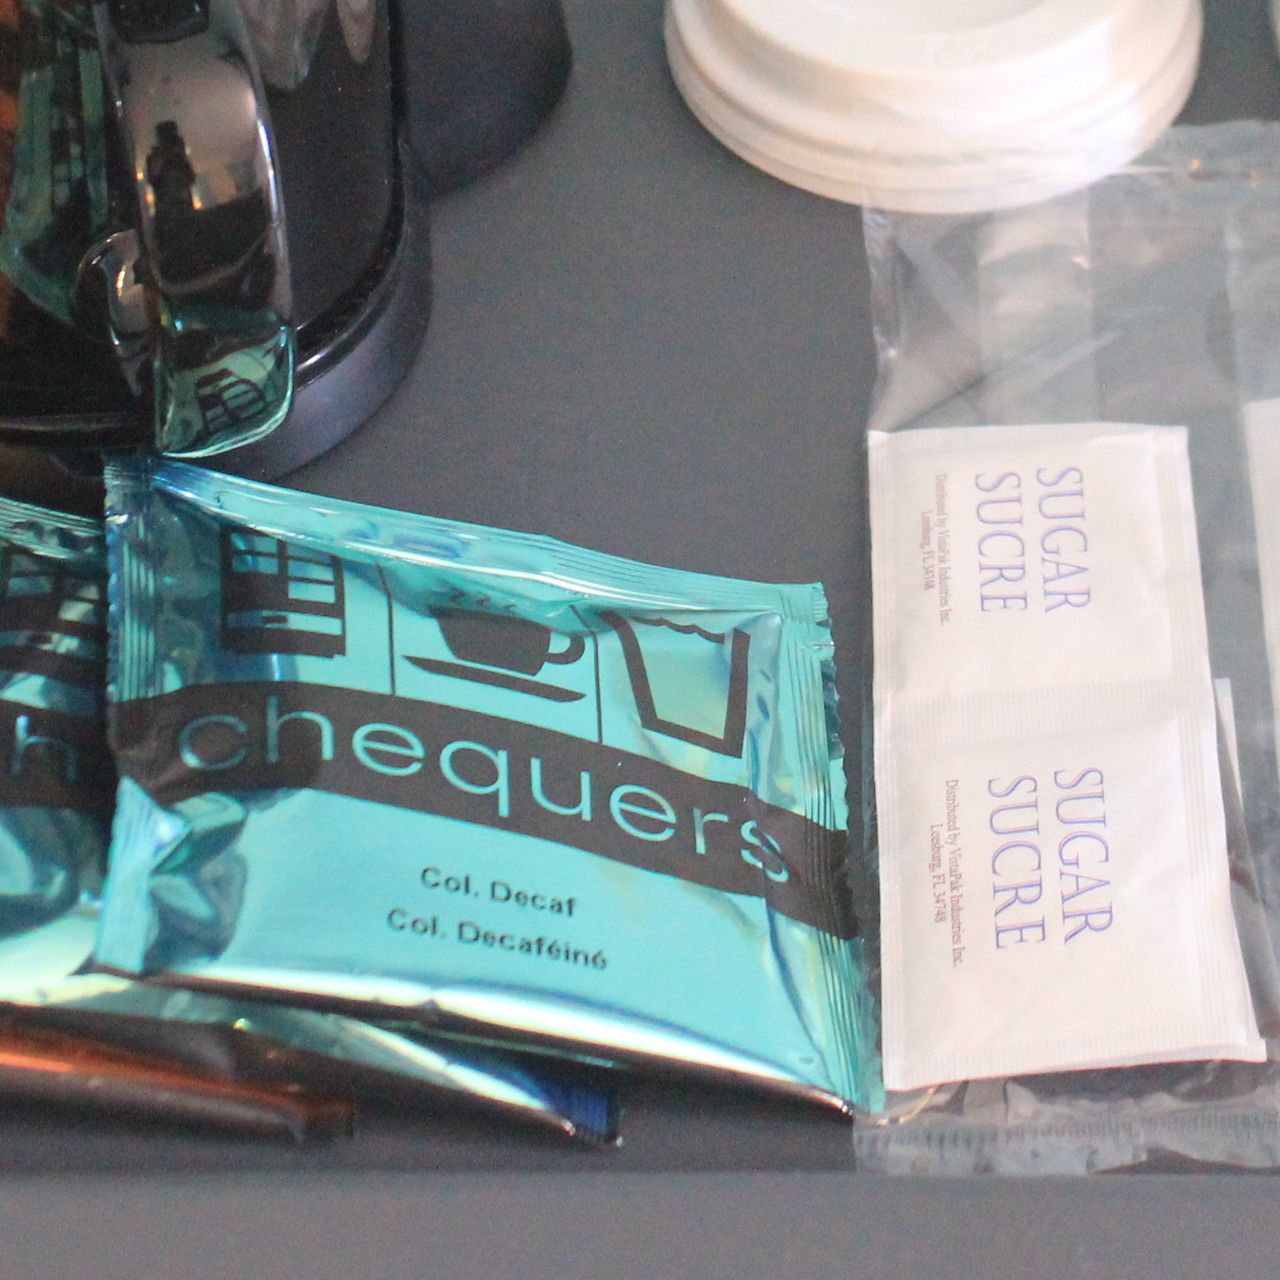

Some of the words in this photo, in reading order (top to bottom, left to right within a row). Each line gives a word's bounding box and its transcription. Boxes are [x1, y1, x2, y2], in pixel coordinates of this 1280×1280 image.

[974, 470, 1028, 612] SUCRE
[1036, 465, 1094, 614] SUGAR
[177, 695, 790, 883] chequers
[987, 774, 1046, 950] SUCRE
[1053, 766, 1115, 945] SUGAR
[386, 907, 447, 939] Col.
[457, 919, 608, 970] Decaféiné
[420, 866, 480, 898] Col.
[490, 879, 577, 918] Decaf
